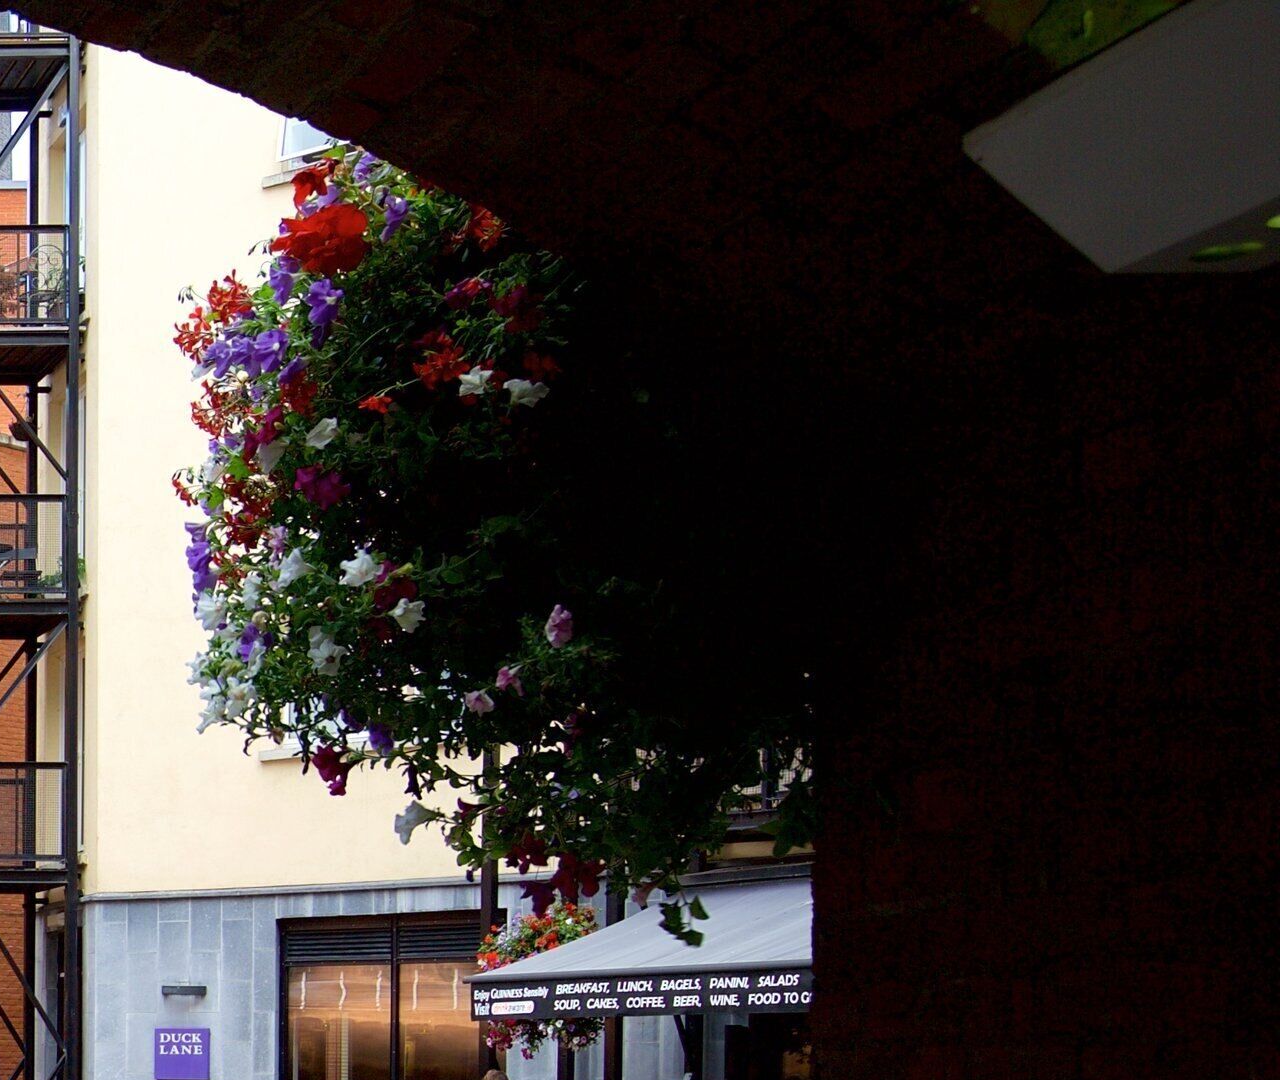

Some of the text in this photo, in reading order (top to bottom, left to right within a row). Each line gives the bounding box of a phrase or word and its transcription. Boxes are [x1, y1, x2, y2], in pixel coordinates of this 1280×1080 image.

[555, 974, 800, 995] BREAKFAST, LUNCH, BAGELS, PANINI, SALADS
[474, 986, 549, 1002] Enjoy GUINNESS Sensibly
[553, 991, 812, 1011] SOUP, CAKES, COFFEE, BEER, WINE, FOOD TO G
[474, 1003, 490, 1016] Visit
[160, 1033, 202, 1043] DUCK
[160, 1045, 203, 1055] LANE
